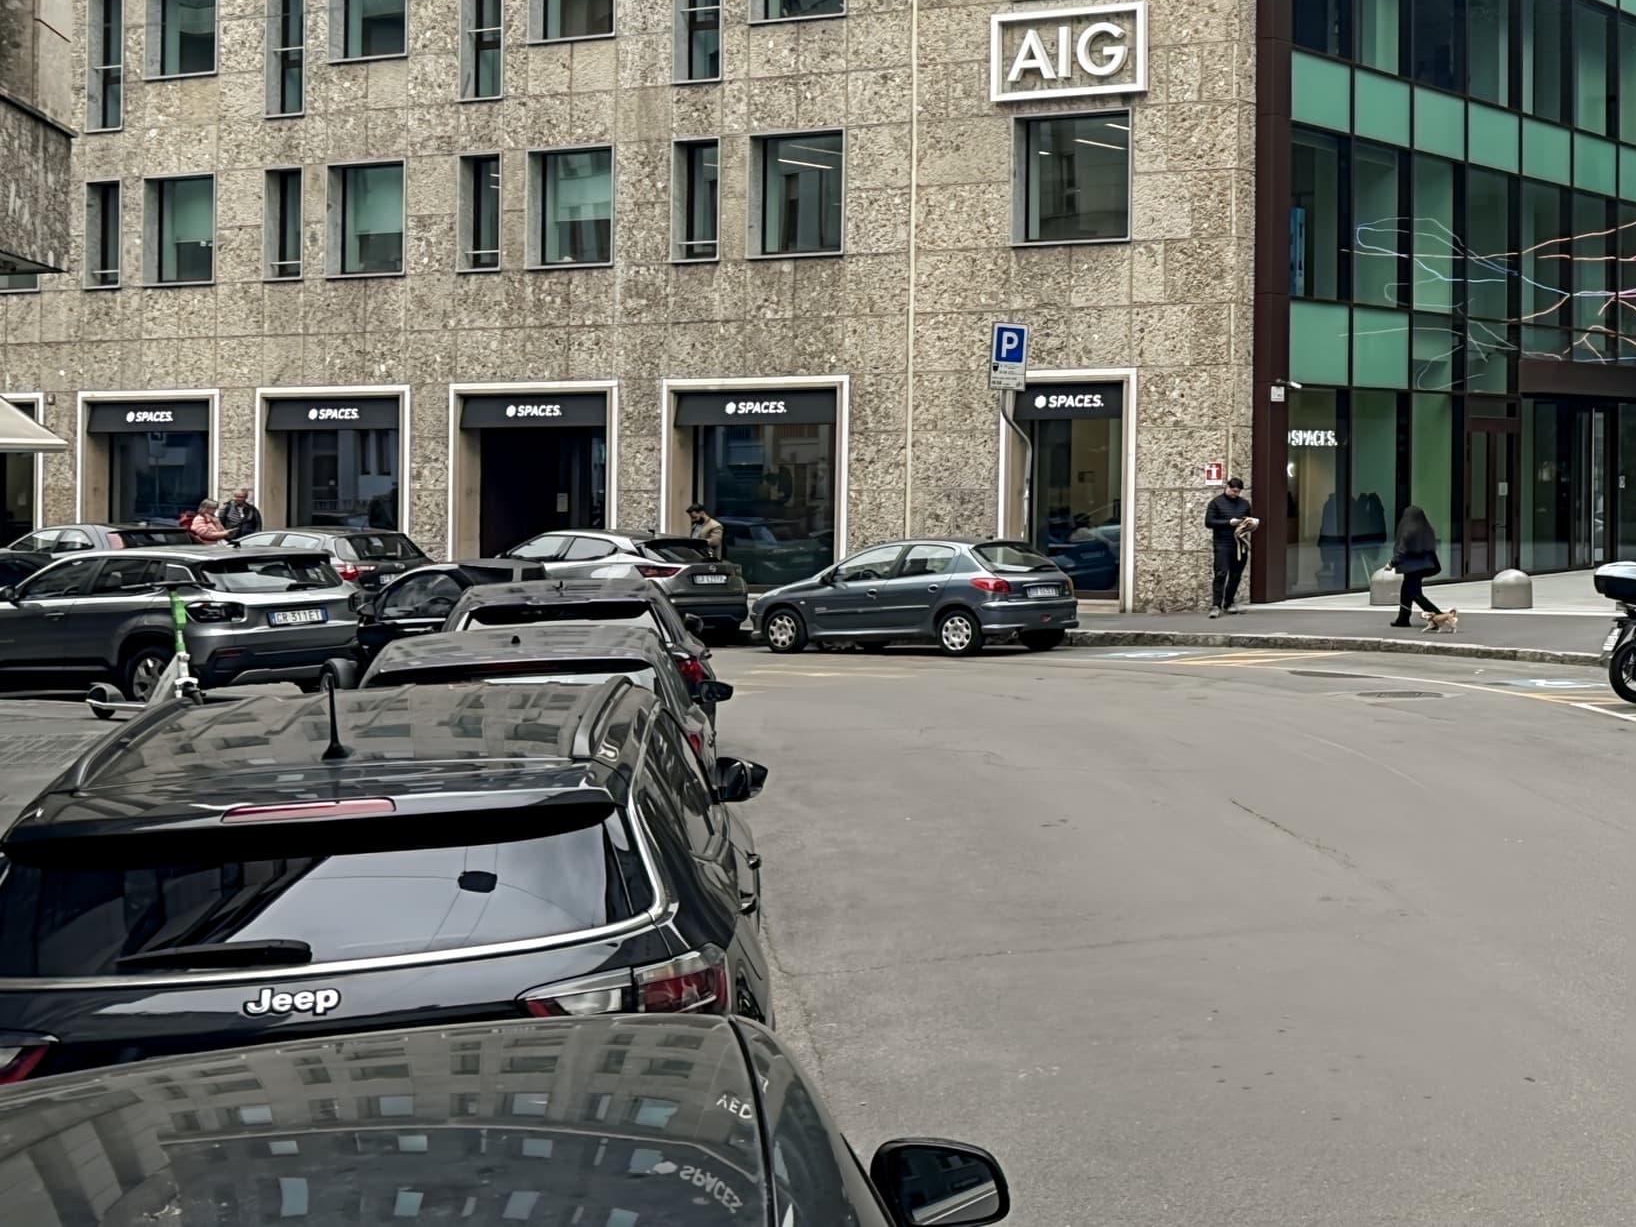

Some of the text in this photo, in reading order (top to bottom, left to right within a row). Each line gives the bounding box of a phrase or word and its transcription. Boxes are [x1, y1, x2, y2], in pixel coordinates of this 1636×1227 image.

[1007, 21, 1129, 82] AIG
[1001, 331, 1019, 358] P
[517, 404, 562, 417] SPACES.
[737, 401, 787, 414] SPACES.
[1048, 394, 1104, 408] SPACES.
[243, 987, 341, 1016] Jeep
